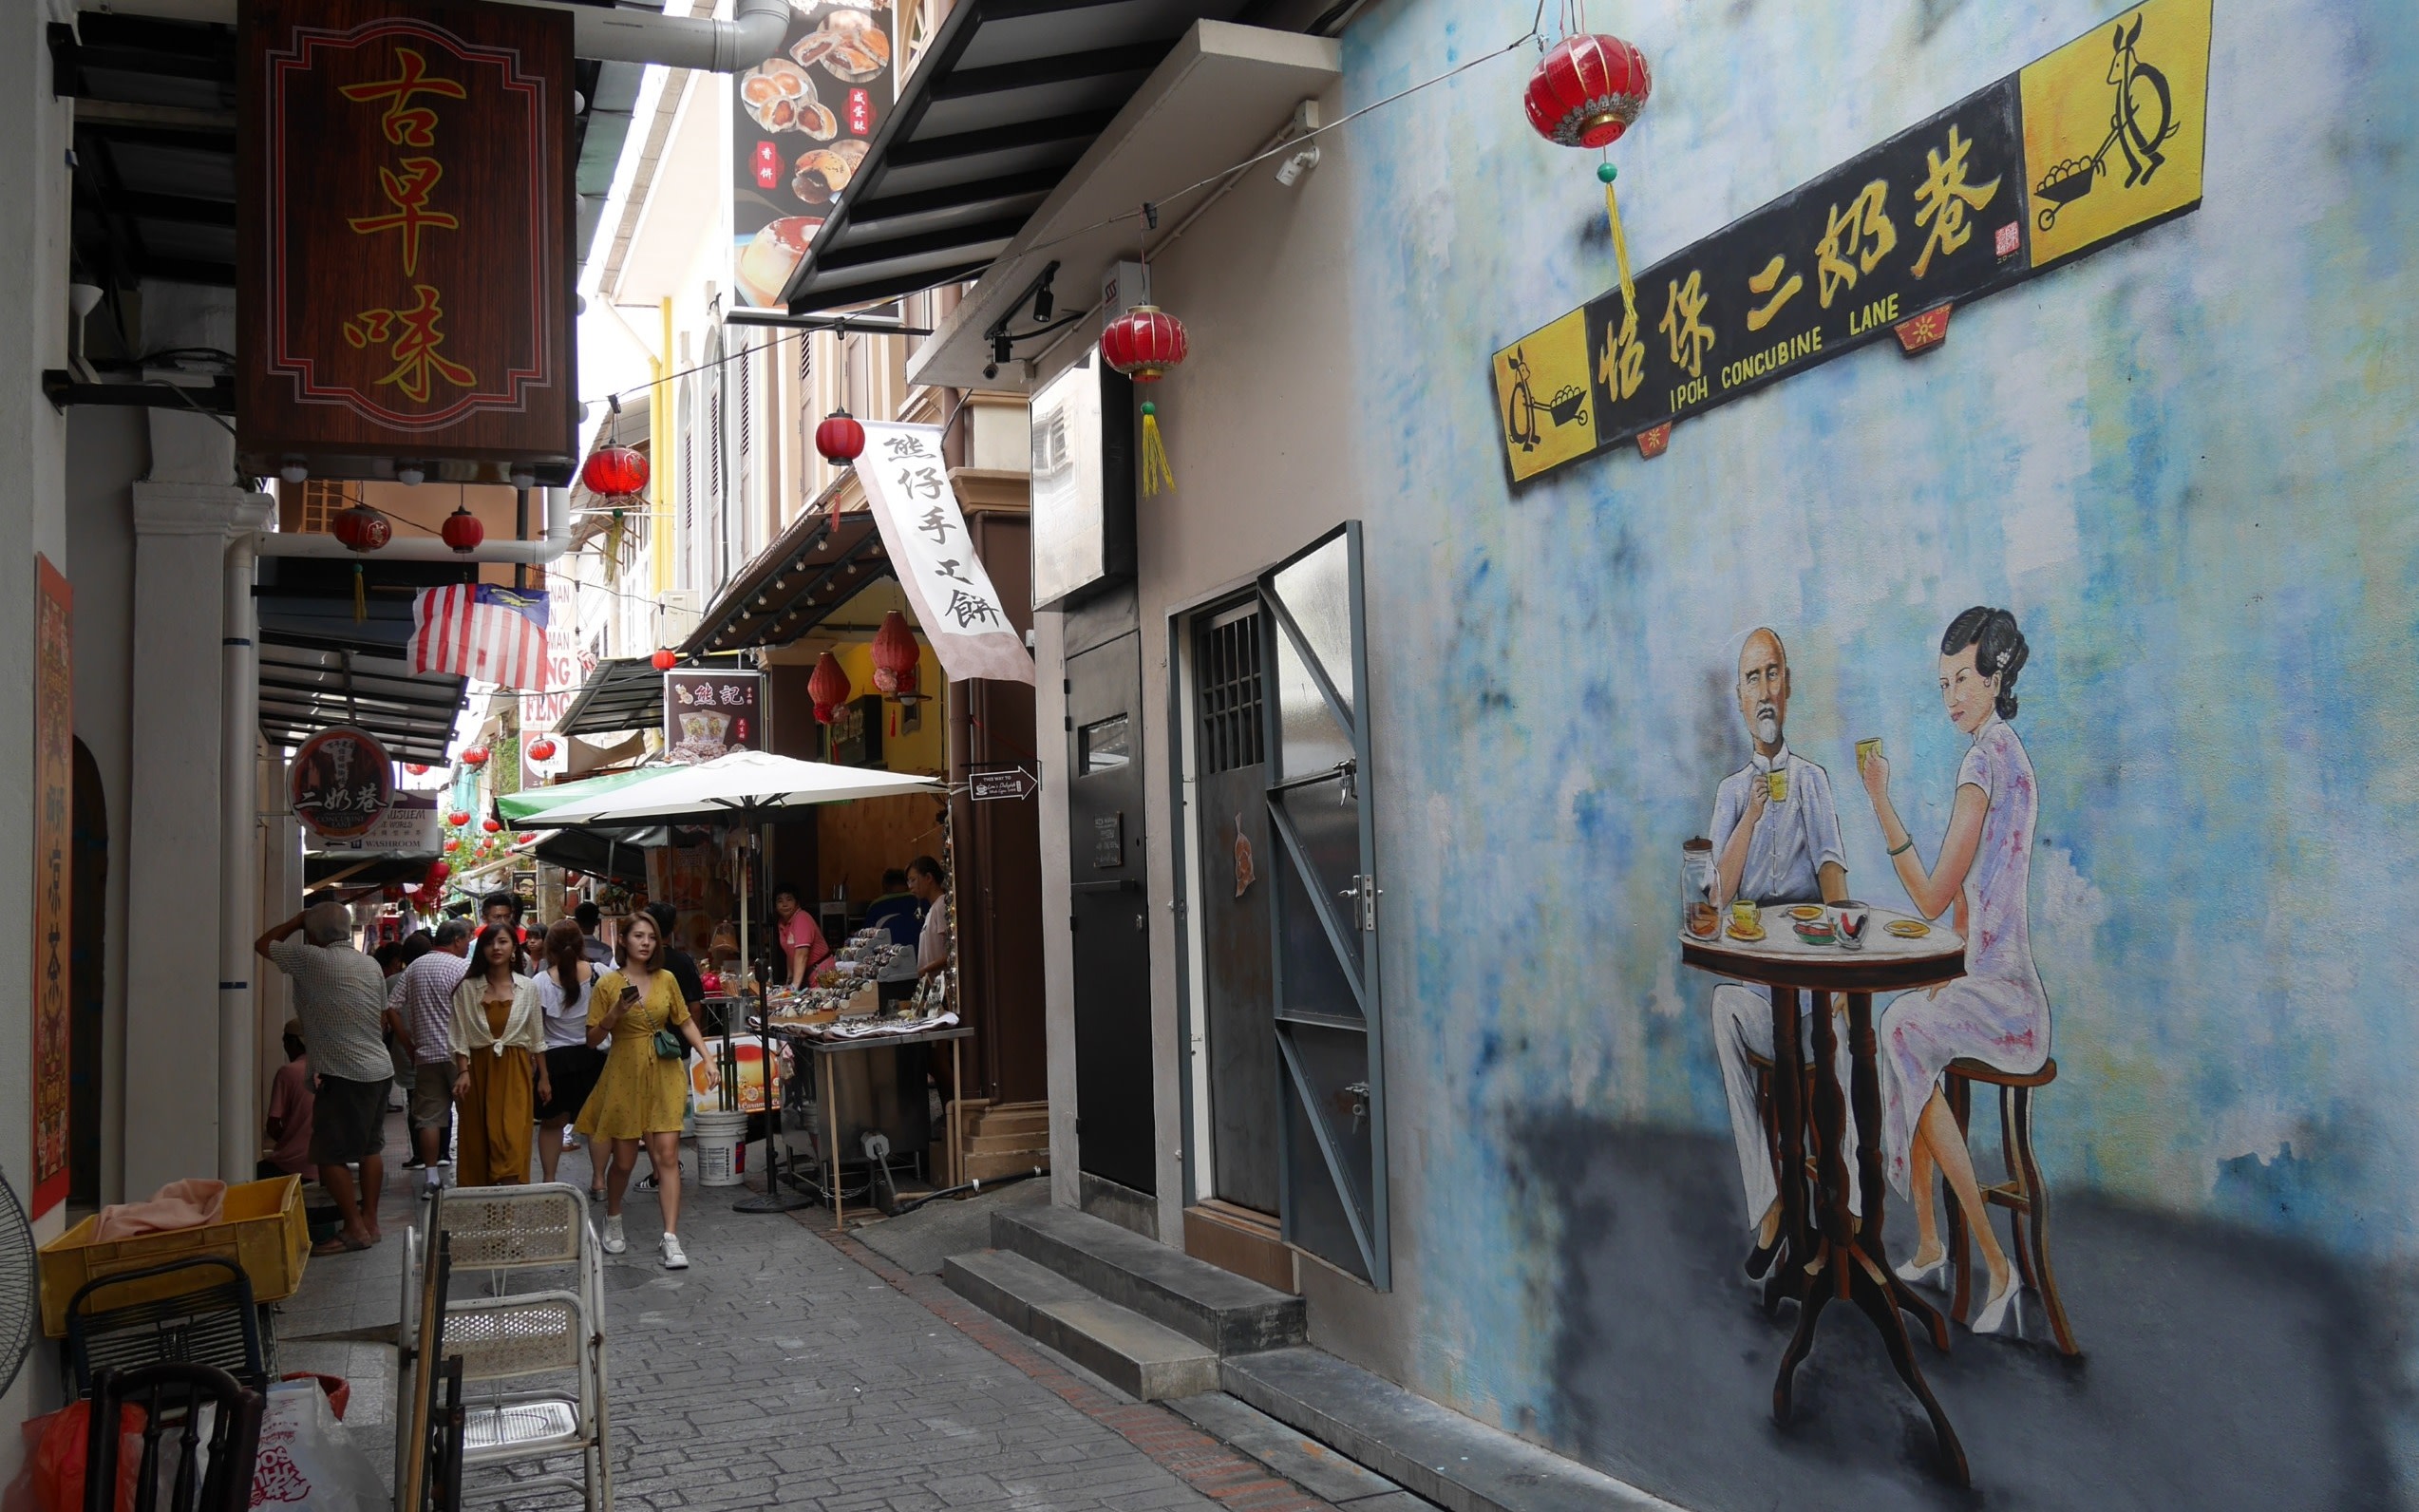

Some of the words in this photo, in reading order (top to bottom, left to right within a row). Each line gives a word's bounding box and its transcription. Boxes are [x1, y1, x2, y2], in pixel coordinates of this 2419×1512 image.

[337, 47, 477, 403] 古早味
[1598, 124, 2001, 403] 怡保二奶巷
[1670, 374, 1709, 413] IPOH
[1721, 326, 1824, 389] CONCUBINE
[1848, 293, 1900, 336] LANE
[883, 433, 1000, 629] 熊仔手工餅
[693, 681, 745, 707] 熊記
[293, 783, 387, 814] 二奶巷
[387, 809, 425, 820] USUEM
